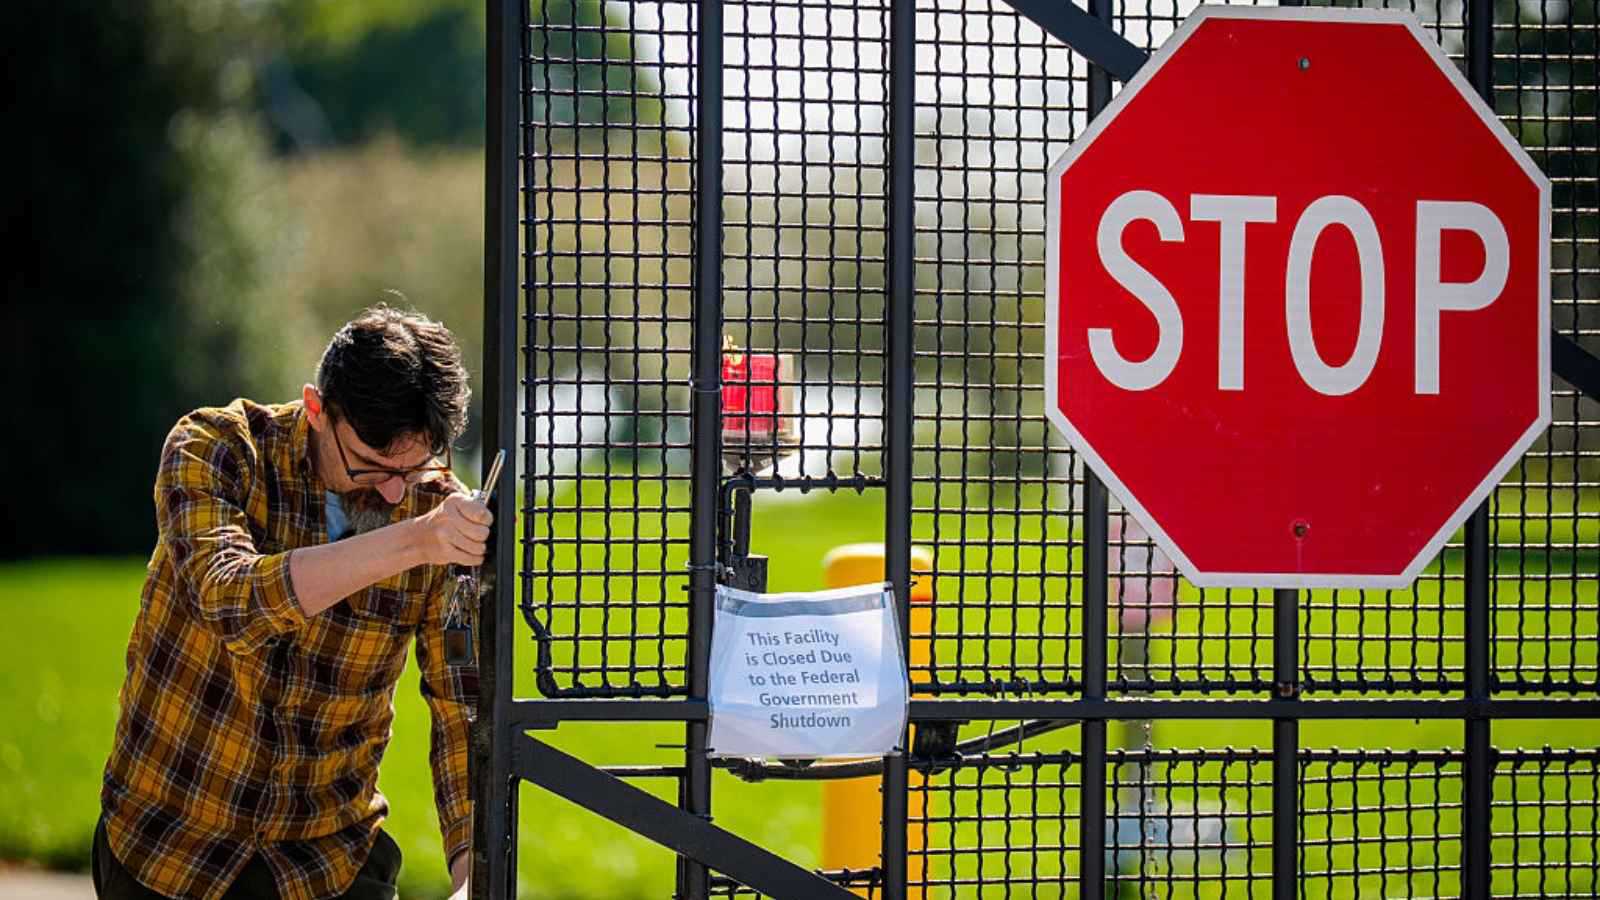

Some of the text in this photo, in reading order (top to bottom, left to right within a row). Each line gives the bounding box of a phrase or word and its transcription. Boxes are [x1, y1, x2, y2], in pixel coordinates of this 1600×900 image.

[1087, 189, 1510, 396] STOP
[747, 629, 840, 646] This Facility
[745, 649, 852, 666] is Closed Due
[748, 668, 861, 686] to the Federal
[759, 692, 858, 706] Government
[770, 712, 851, 729] Shutdown
